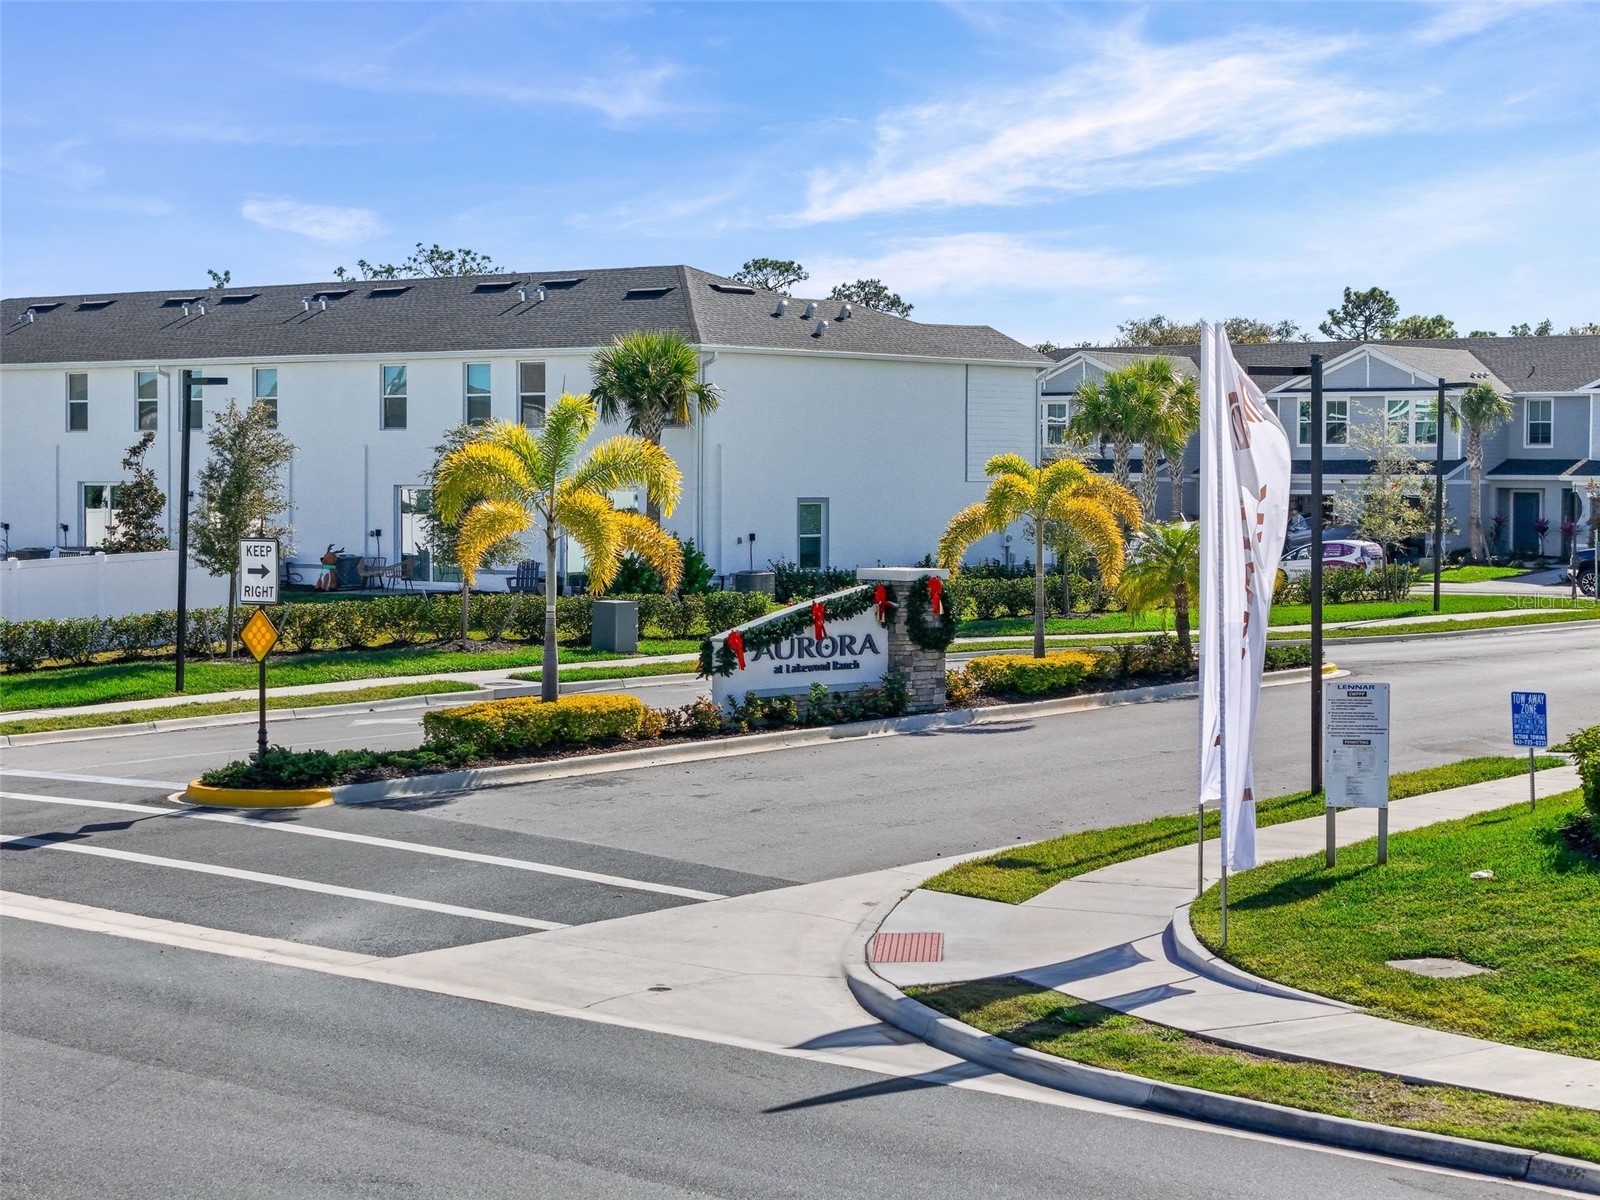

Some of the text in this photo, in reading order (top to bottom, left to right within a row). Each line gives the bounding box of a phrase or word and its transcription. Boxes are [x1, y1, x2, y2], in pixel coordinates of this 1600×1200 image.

[246, 545, 272, 557] KEEP
[244, 586, 274, 598] RIGHT
[751, 633, 881, 662] AURORA
[773, 660, 860, 674] at Lakewood Ranch
[1512, 693, 1545, 704] TOW AWAY
[1521, 704, 1537, 714] ZONE
